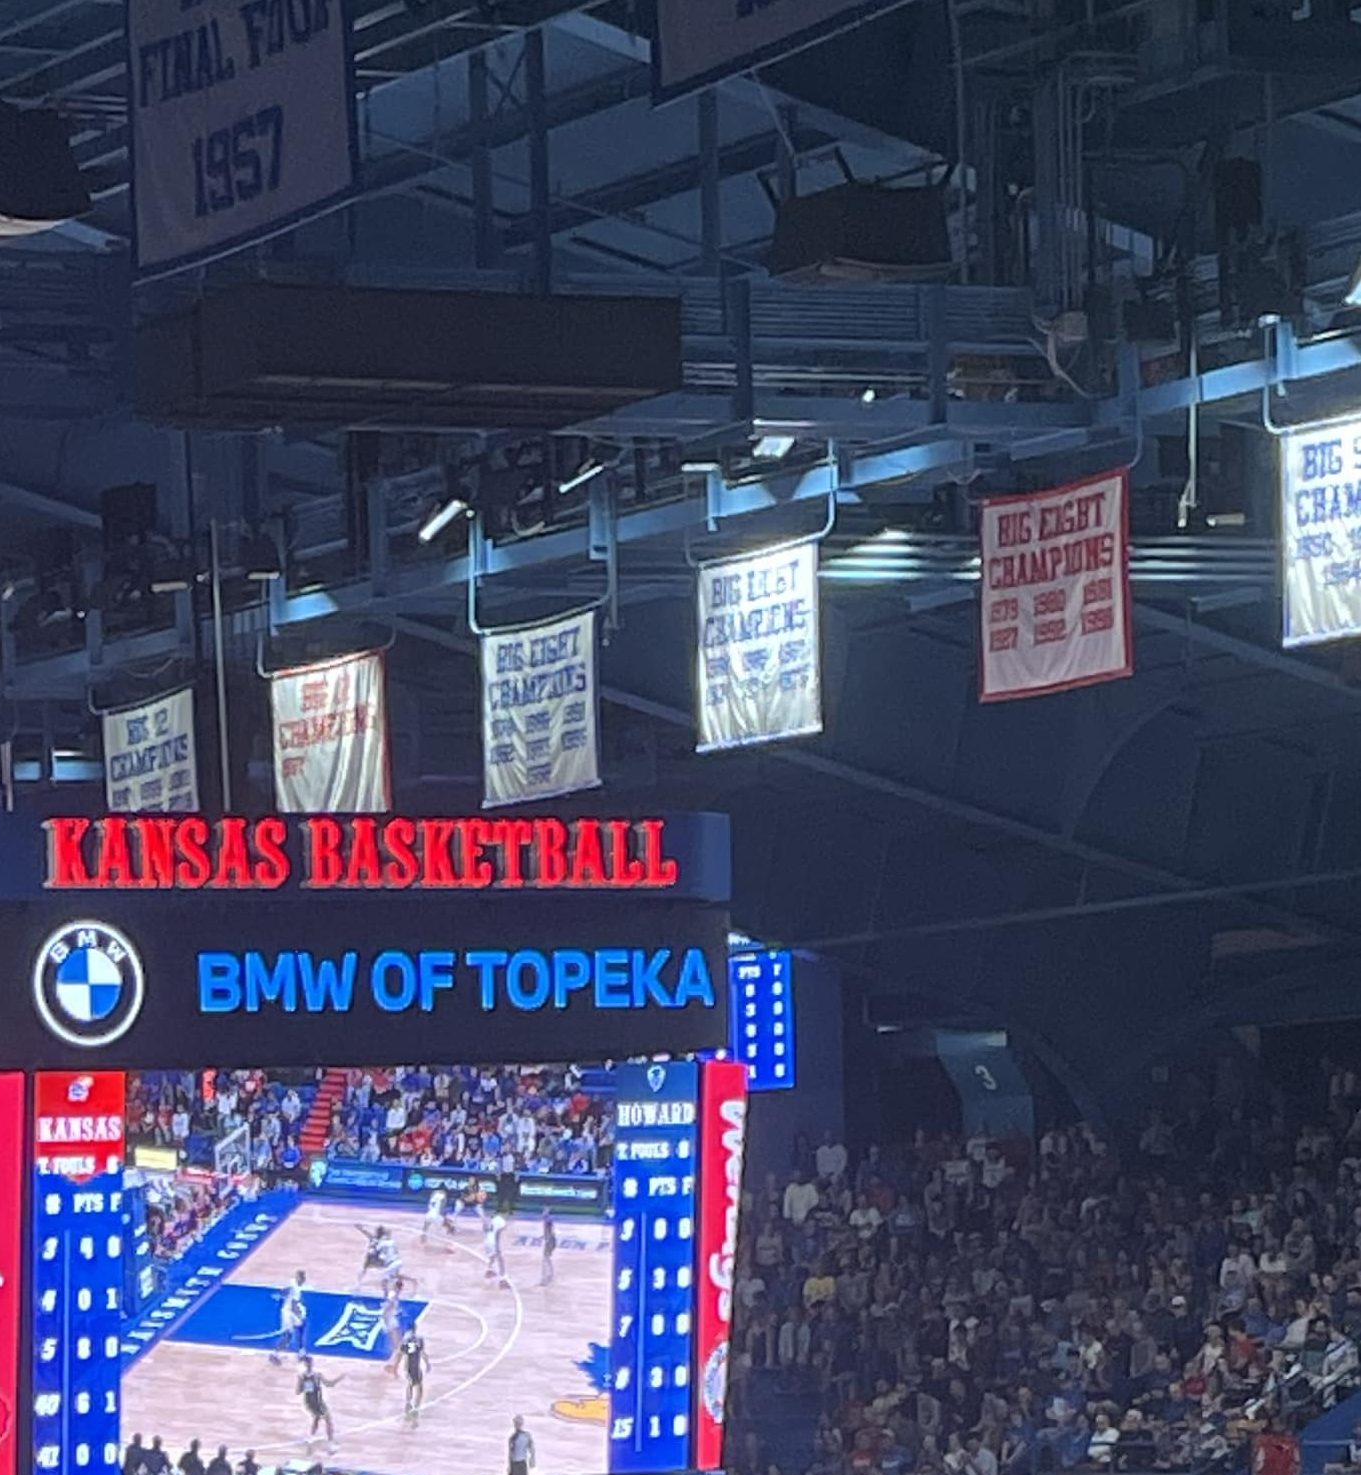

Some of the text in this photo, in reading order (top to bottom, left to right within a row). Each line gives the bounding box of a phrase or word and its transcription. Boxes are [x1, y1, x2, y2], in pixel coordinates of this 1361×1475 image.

[140, 18, 235, 108] FINAL
[191, 104, 285, 218] 1957
[1302, 439, 1344, 482] BIG
[997, 492, 1107, 547] BIG EIGHT
[988, 534, 1114, 590] CHAMPIONS
[712, 575, 742, 607] BIG
[497, 626, 580, 675] BIG EIGHT
[490, 662, 586, 711] CHAMPIONS
[45, 815, 680, 889] KANSAS BASKETBALL
[50, 931, 127, 963] BMW
[198, 947, 715, 1012] BMW OF TOPEKA
[974, 1065, 997, 1091] 3
[38, 1116, 122, 1142] KANSAS
[617, 1102, 696, 1127] HOWARD
[648, 1176, 693, 1196] PTS F
[73, 1192, 122, 1213] PTS F
[41, 1288, 57, 1310] 4
[105, 1287, 118, 1310] 1
[620, 1315, 633, 1338] 7
[40, 1338, 58, 1361] 5
[104, 1390, 117, 1413] 1
[612, 1417, 634, 1439] 15
[650, 1416, 661, 1438] 1
